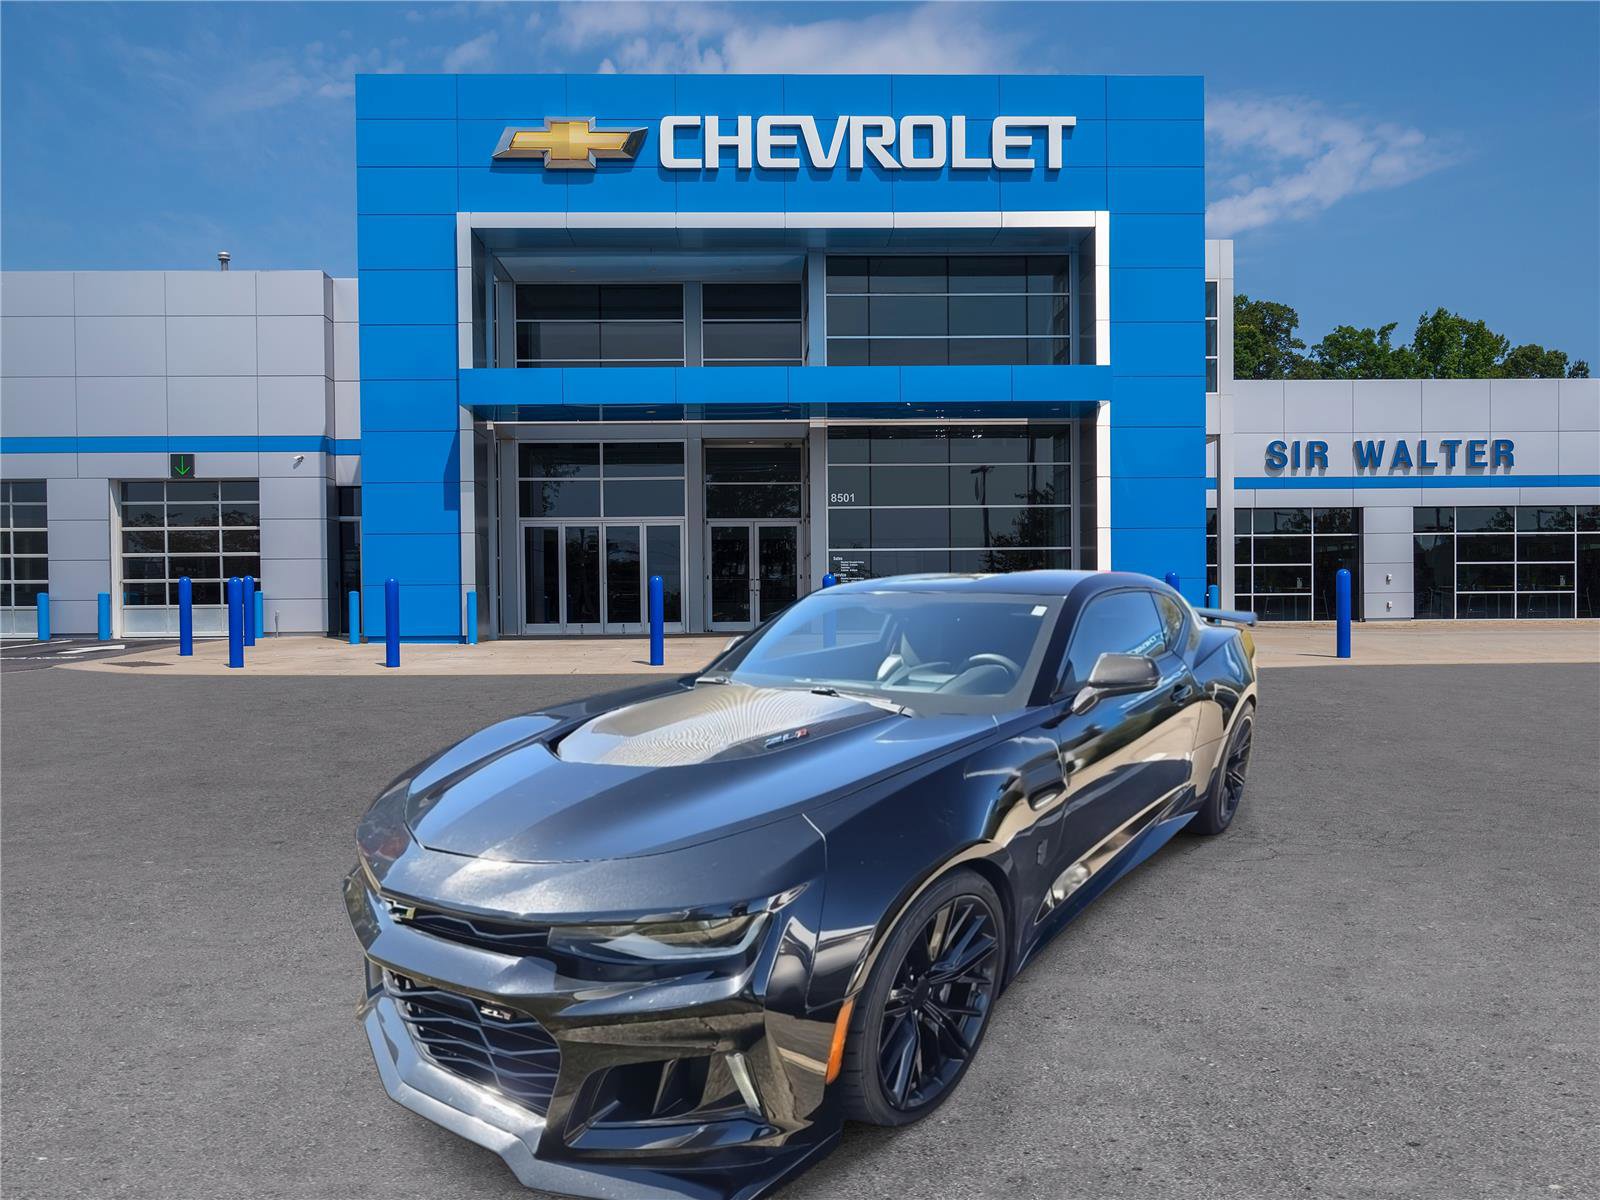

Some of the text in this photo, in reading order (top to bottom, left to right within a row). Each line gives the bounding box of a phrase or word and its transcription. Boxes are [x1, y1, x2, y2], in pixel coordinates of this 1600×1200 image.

[660, 115, 1077, 170] CHEVROLET
[1265, 439, 1516, 470] SIR WALTER
[830, 493, 855, 503] 8501
